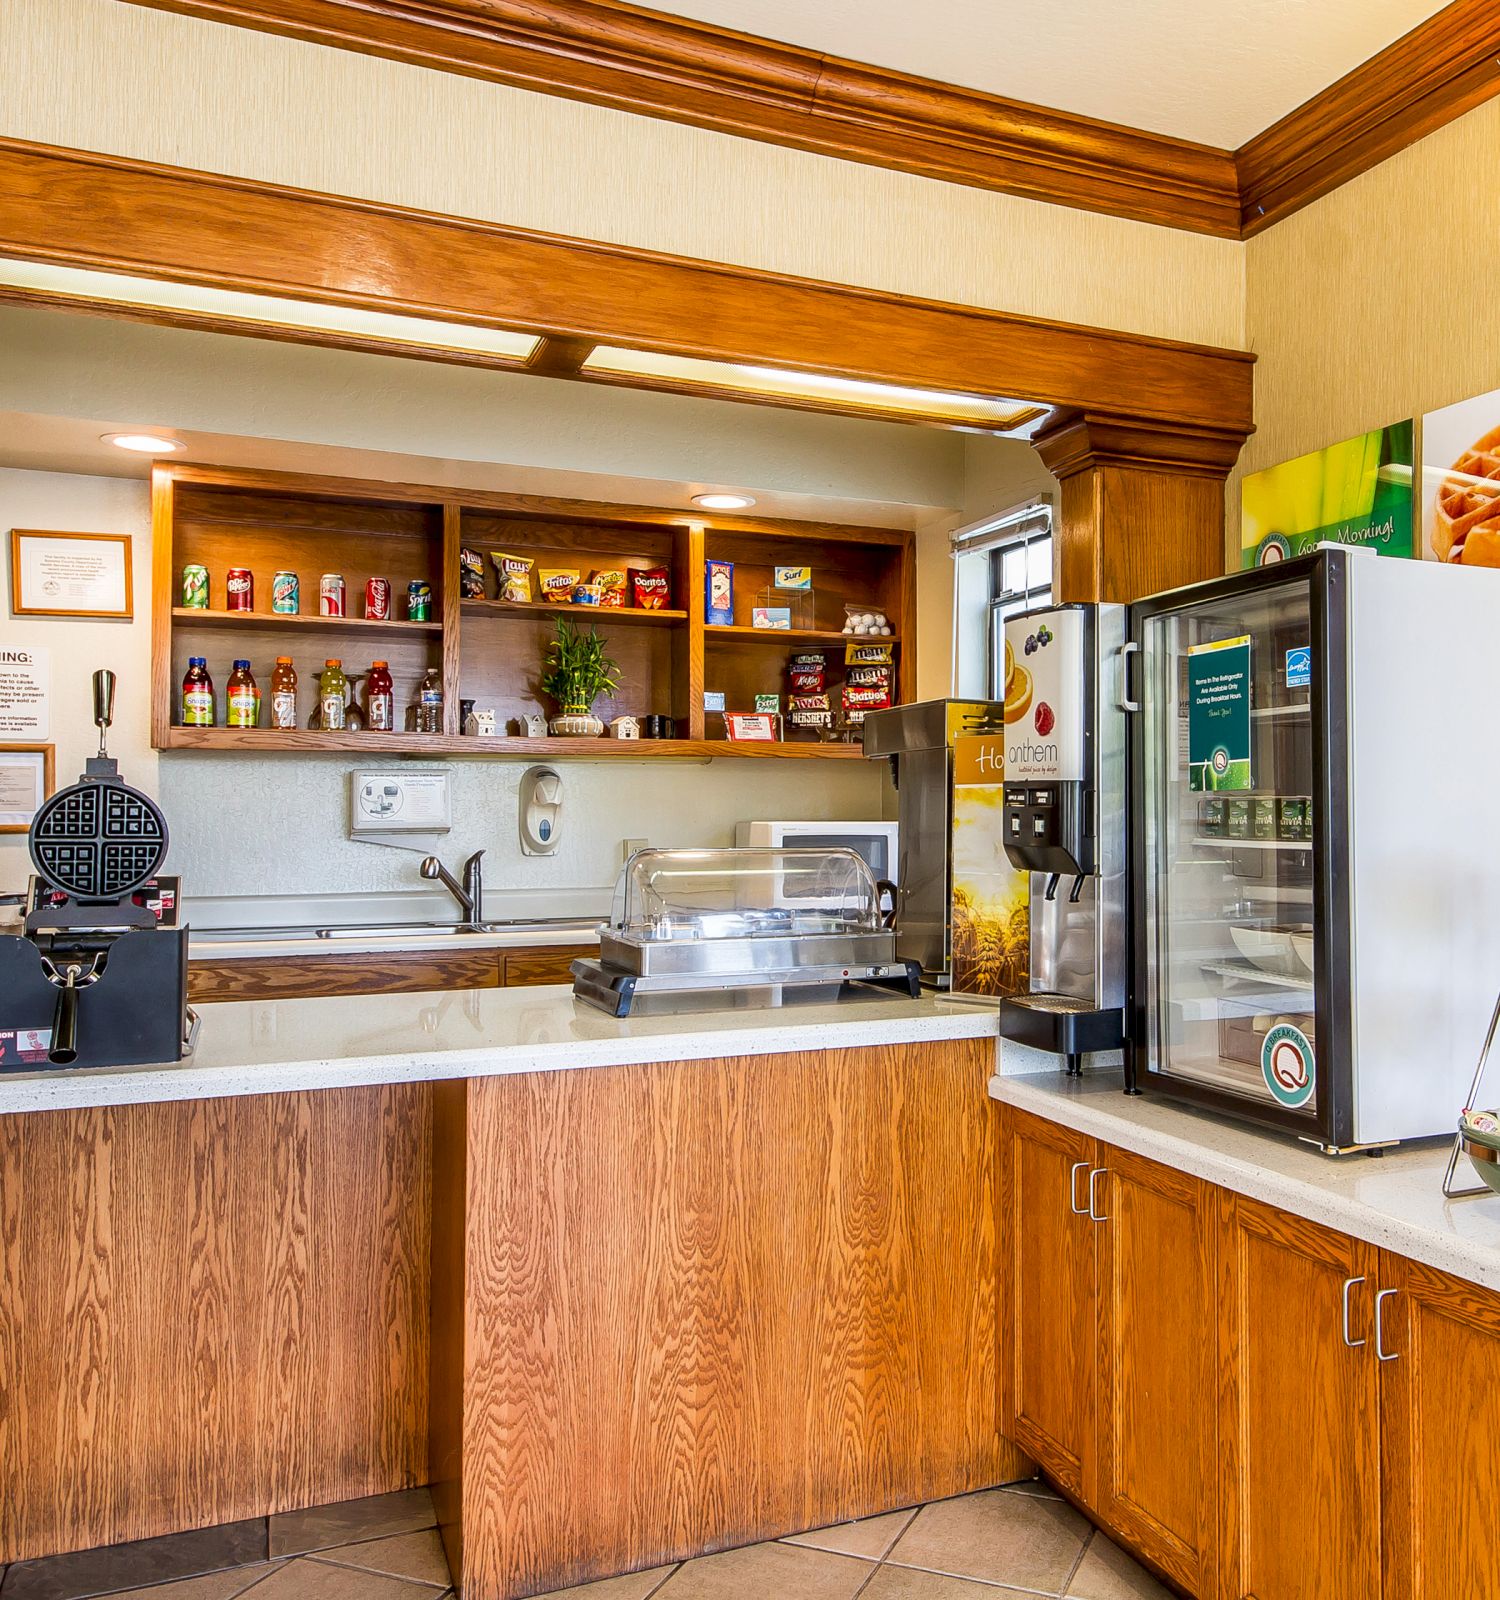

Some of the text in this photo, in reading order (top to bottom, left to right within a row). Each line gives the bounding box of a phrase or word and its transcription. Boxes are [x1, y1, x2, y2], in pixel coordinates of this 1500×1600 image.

[1337, 516, 1394, 543] Morning!
[546, 576, 574, 588] Fritos
[634, 577, 667, 587] Doritos
[783, 570, 803, 582] Surf
[408, 594, 432, 608] Sprit
[0, 652, 32, 663] ING:
[849, 692, 887, 703] Skittles
[1009, 737, 1057, 764] anthem
[975, 745, 1004, 774] Ho
[1269, 1029, 1308, 1051] BREAKFAST
